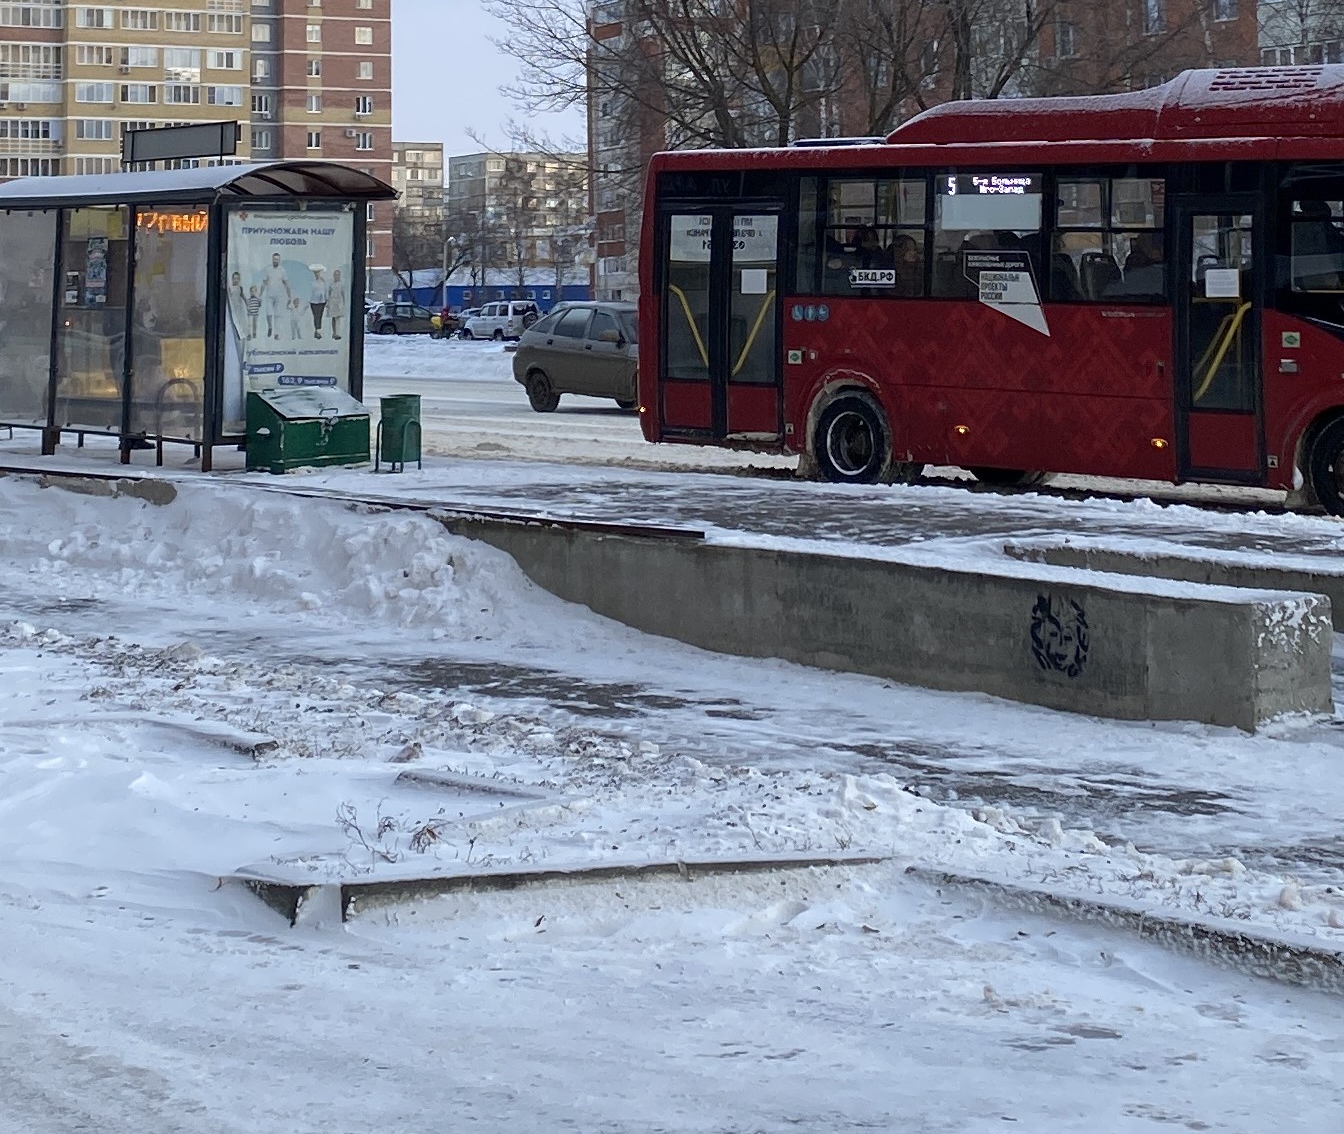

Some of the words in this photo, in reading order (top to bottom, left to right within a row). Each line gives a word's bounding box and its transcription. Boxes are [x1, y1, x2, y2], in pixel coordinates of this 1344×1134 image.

[947, 176, 957, 195] 5
[241, 227, 309, 235] ПРИУМНОЖАЕМ
[270, 237, 307, 246] ЛЮБОВЬ
[858, 271, 894, 282] БКД.РФ
